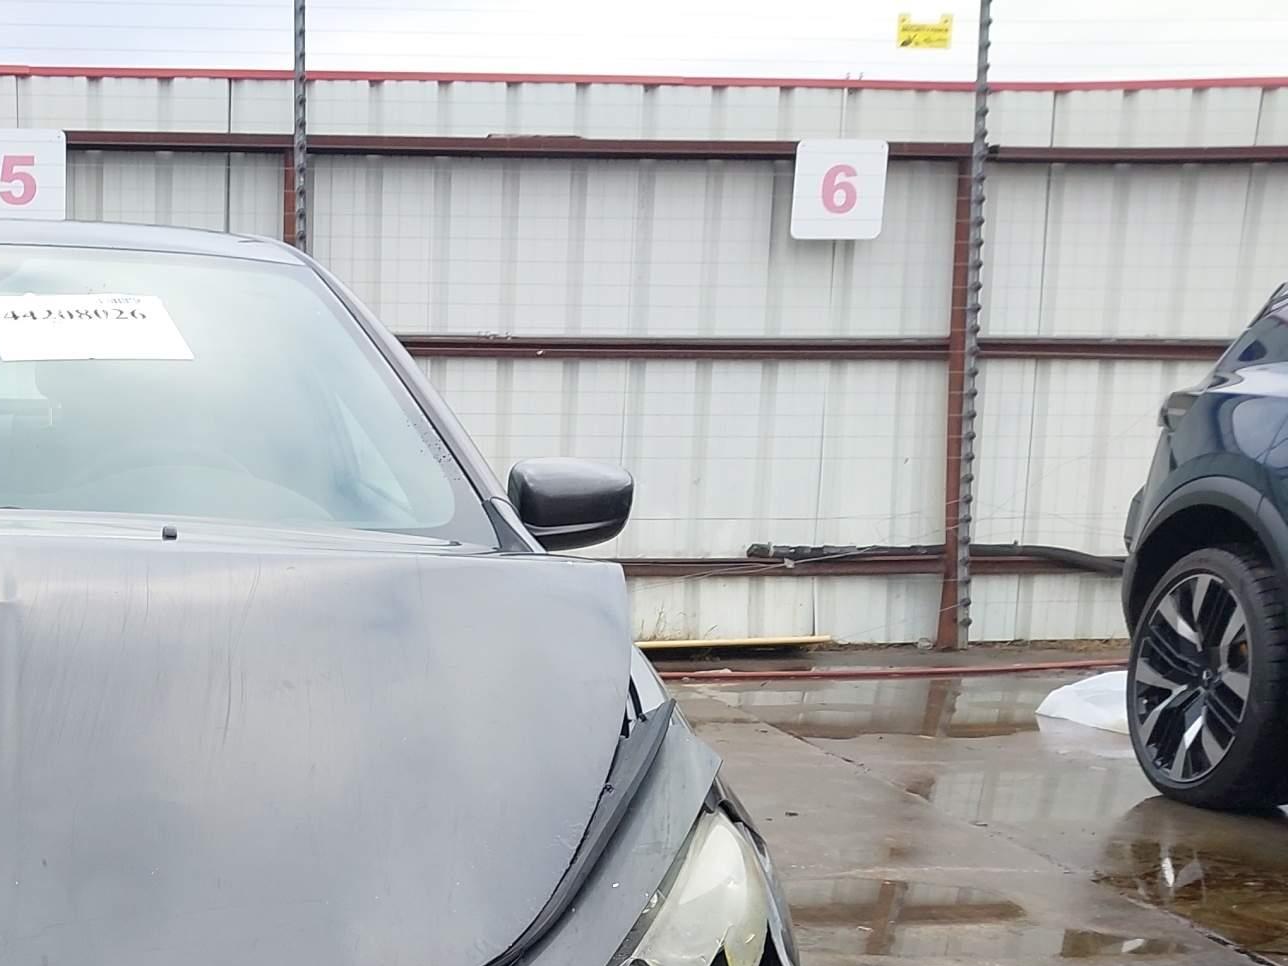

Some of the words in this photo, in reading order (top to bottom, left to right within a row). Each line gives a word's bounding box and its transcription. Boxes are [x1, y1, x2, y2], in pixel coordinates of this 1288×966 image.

[0, 155, 37, 205] 5
[821, 165, 858, 214] 6
[3, 308, 148, 321] 44208026
